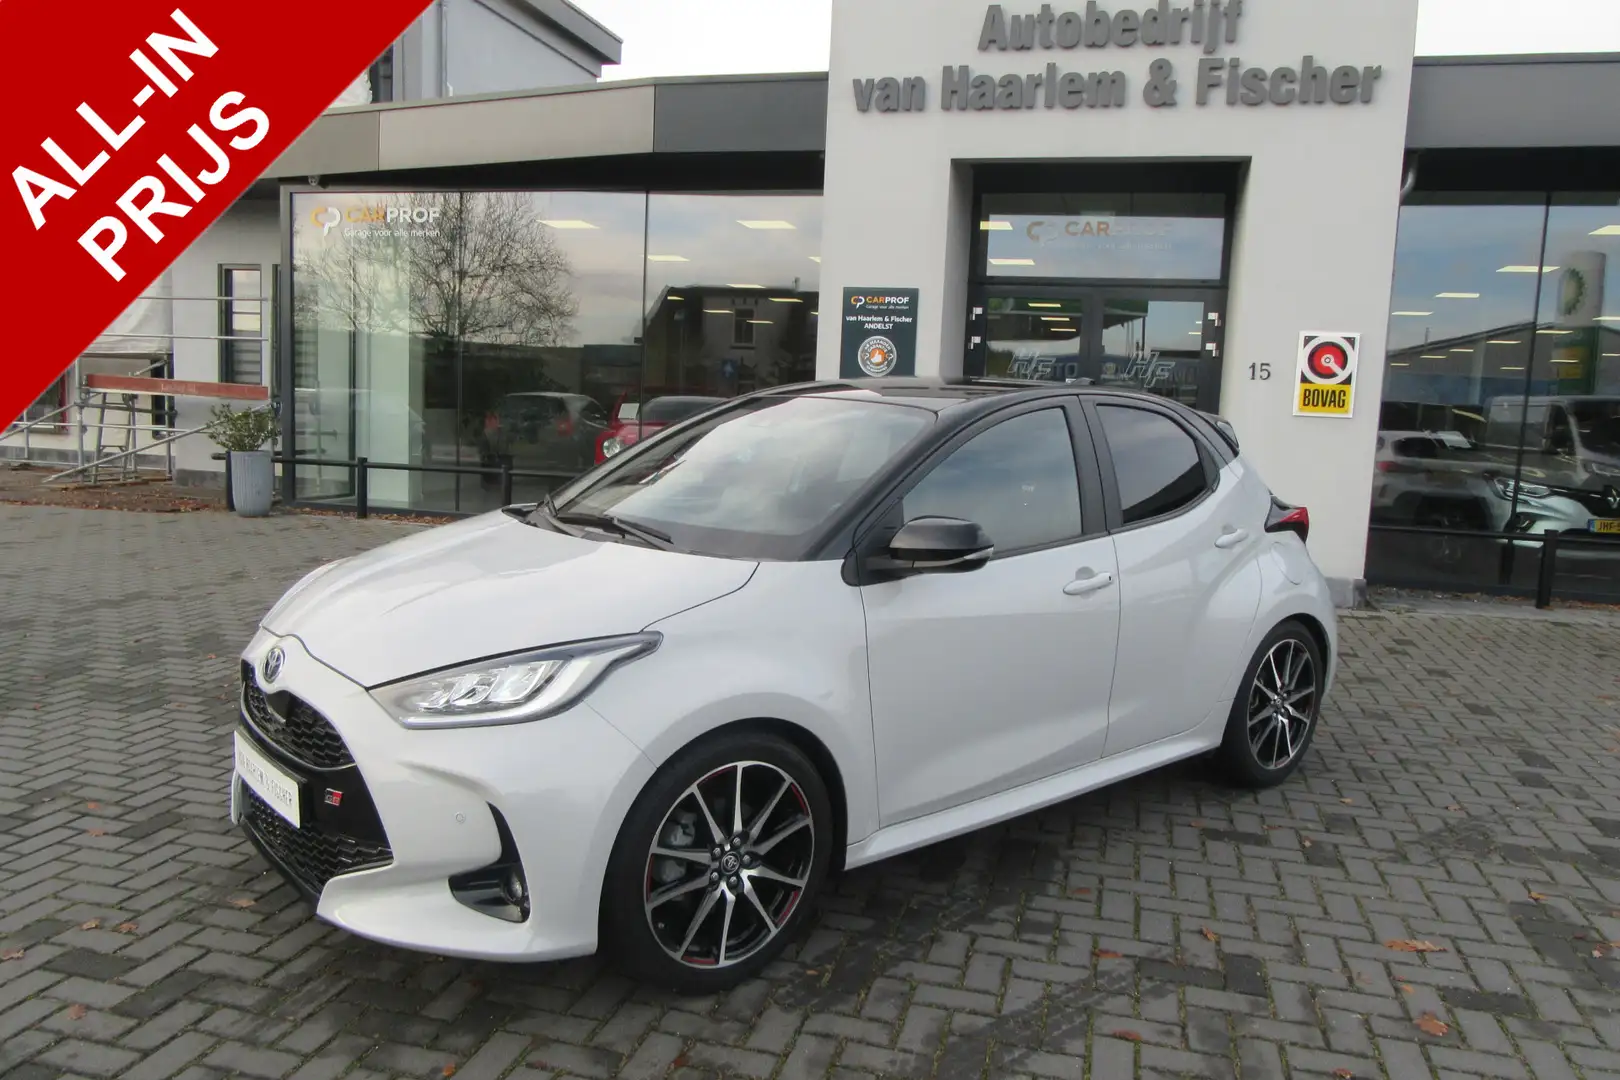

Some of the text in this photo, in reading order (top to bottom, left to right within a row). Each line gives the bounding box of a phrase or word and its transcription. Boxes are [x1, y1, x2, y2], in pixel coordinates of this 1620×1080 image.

[977, 0, 1243, 54] Autobedrijf
[852, 55, 1382, 113] van Haarlem & Fischer
[345, 207, 441, 223] CARPROF
[344, 228, 441, 239] Garage voor alle merken
[866, 296, 910, 304] CARPROF
[1249, 362, 1271, 380] 15
[1303, 388, 1347, 408] BOVAG
